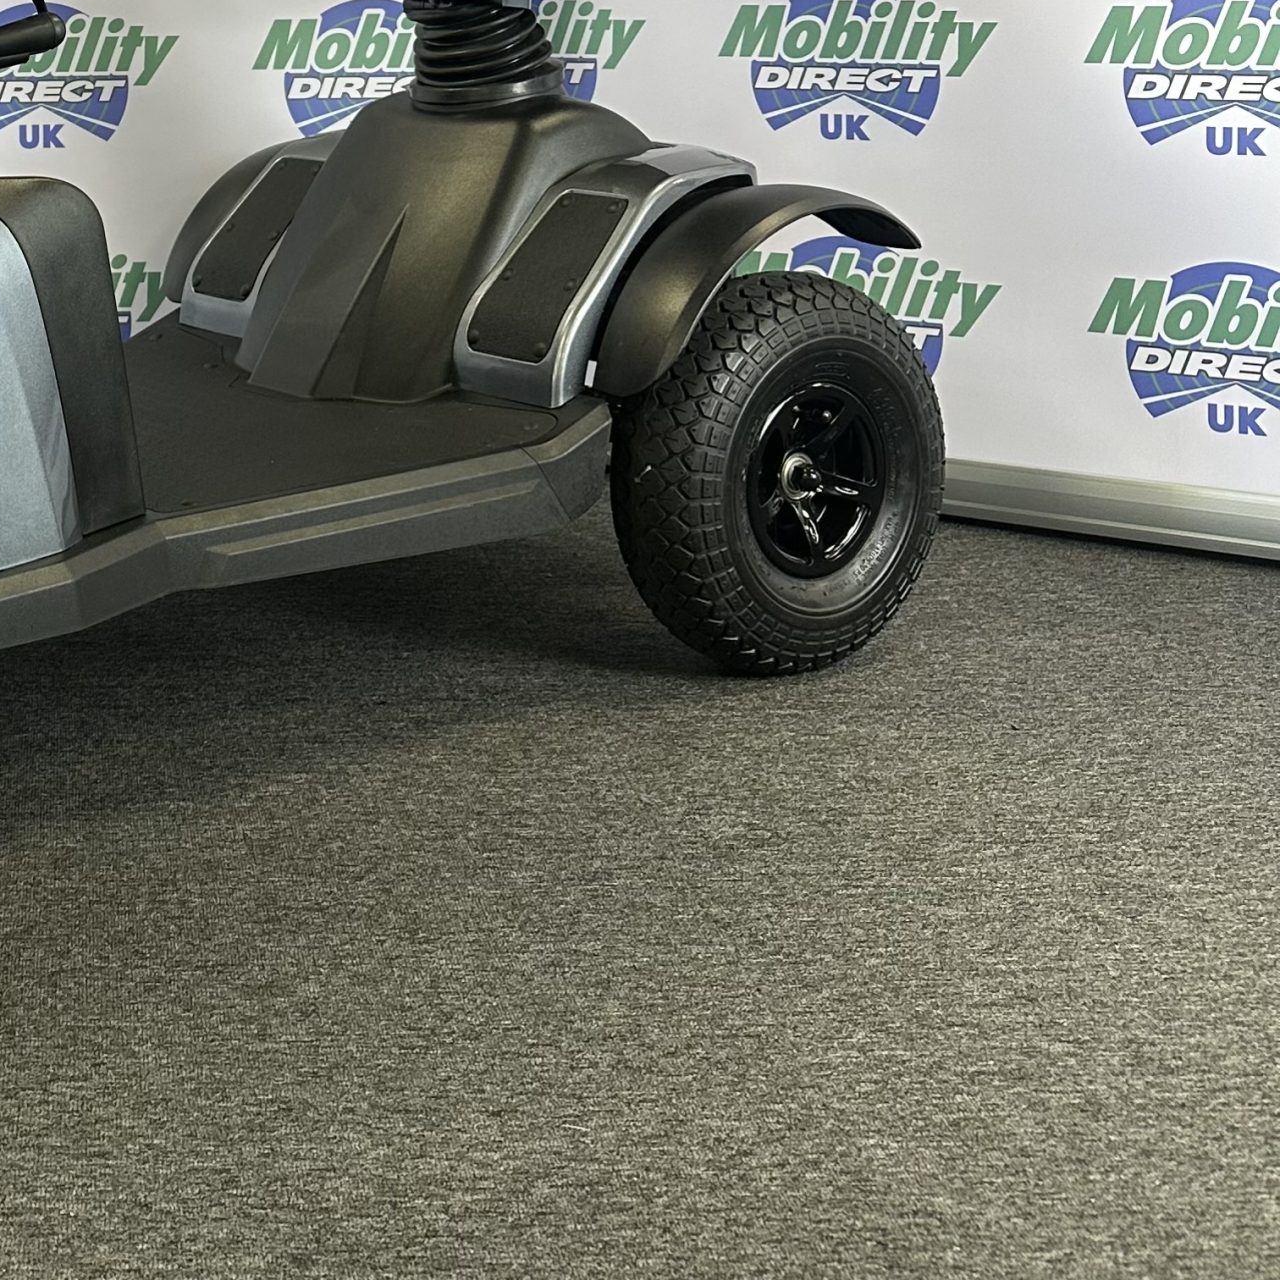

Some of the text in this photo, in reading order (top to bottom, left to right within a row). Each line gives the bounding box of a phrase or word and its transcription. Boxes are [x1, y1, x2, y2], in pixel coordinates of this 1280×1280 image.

[717, 0, 1000, 78] Mobility
[754, 66, 938, 93] DIRECT
[18, 123, 66, 150] UK
[819, 113, 871, 142] UK
[1205, 126, 1267, 157] UK
[1207, 402, 1268, 437] UK
